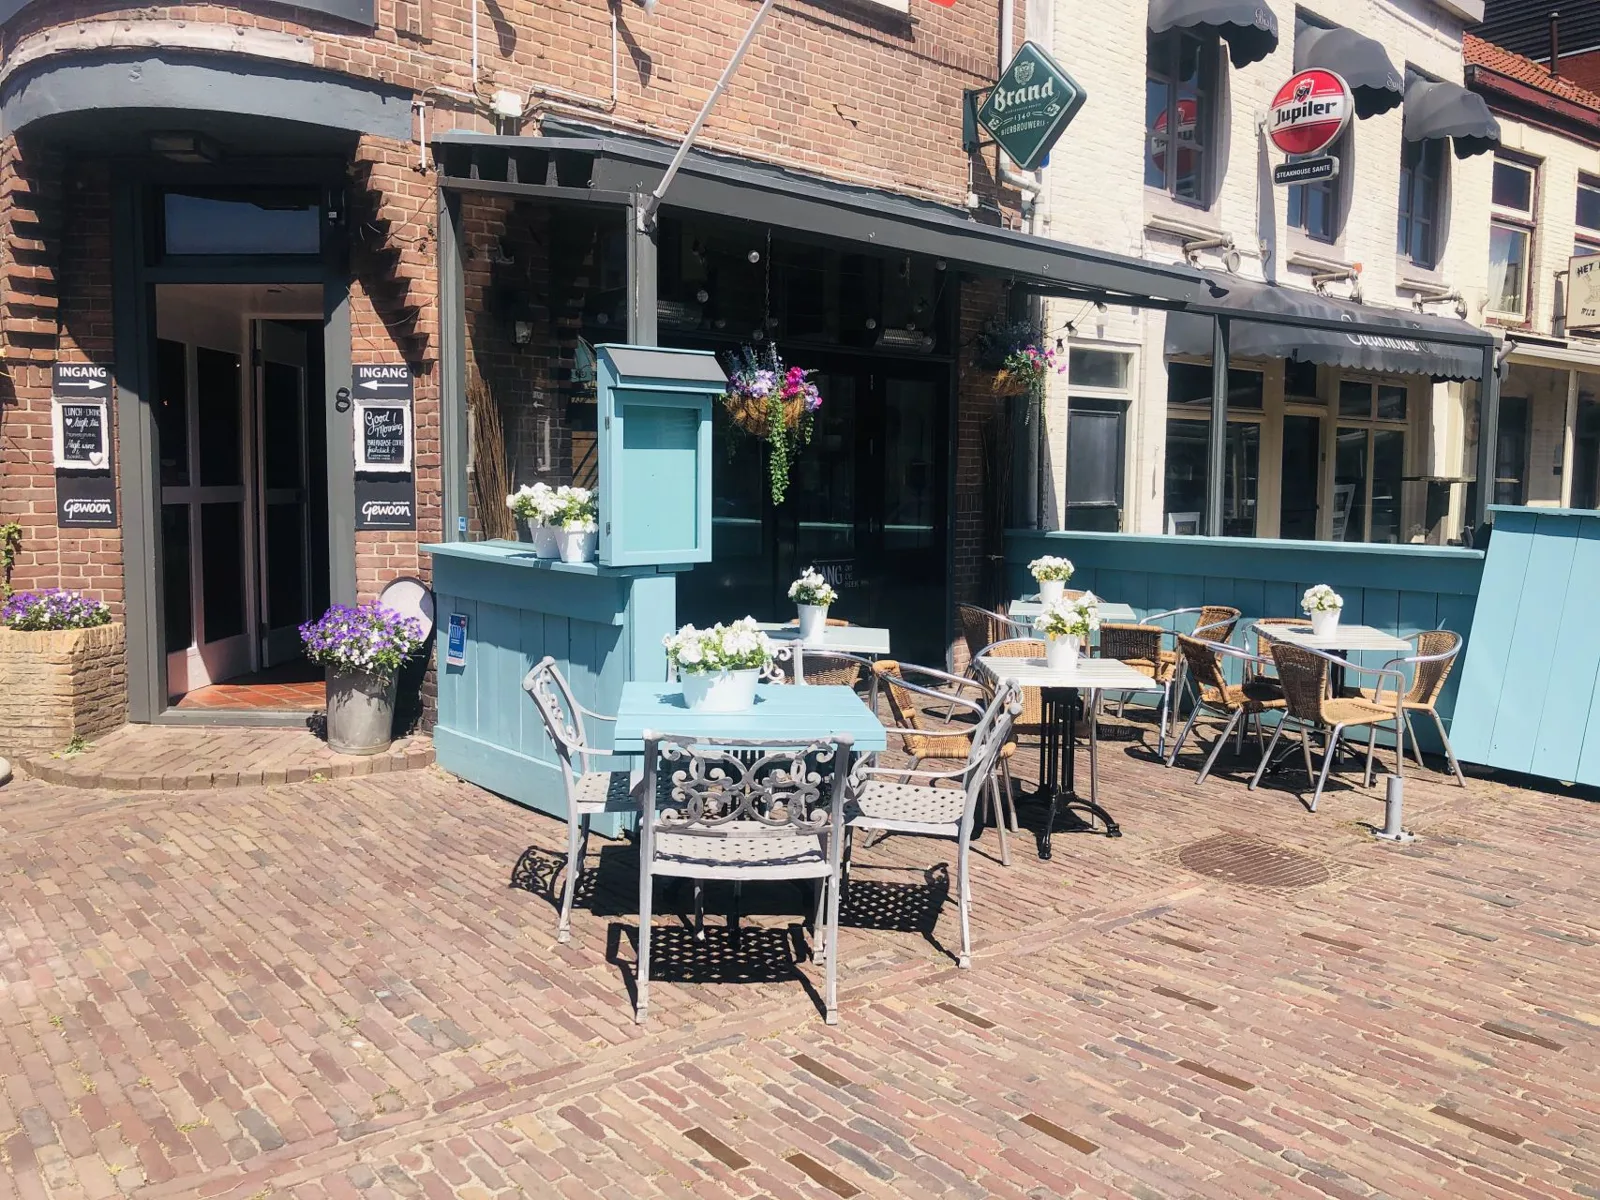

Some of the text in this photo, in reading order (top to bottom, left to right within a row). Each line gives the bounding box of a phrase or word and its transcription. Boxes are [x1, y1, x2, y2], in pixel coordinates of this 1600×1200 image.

[994, 76, 1055, 112] Brand
[1014, 111, 1031, 121] 1340
[1275, 101, 1337, 126] Jupiler
[1276, 164, 1331, 179] STEAKHOUSE SANTE
[1577, 262, 1594, 276] HET
[59, 366, 107, 378] INGANG
[359, 367, 408, 379] INGANG
[335, 386, 351, 413] 8
[364, 410, 390, 436] Good
[63, 499, 112, 519] Gewoon
[362, 501, 411, 521] Gewoon
